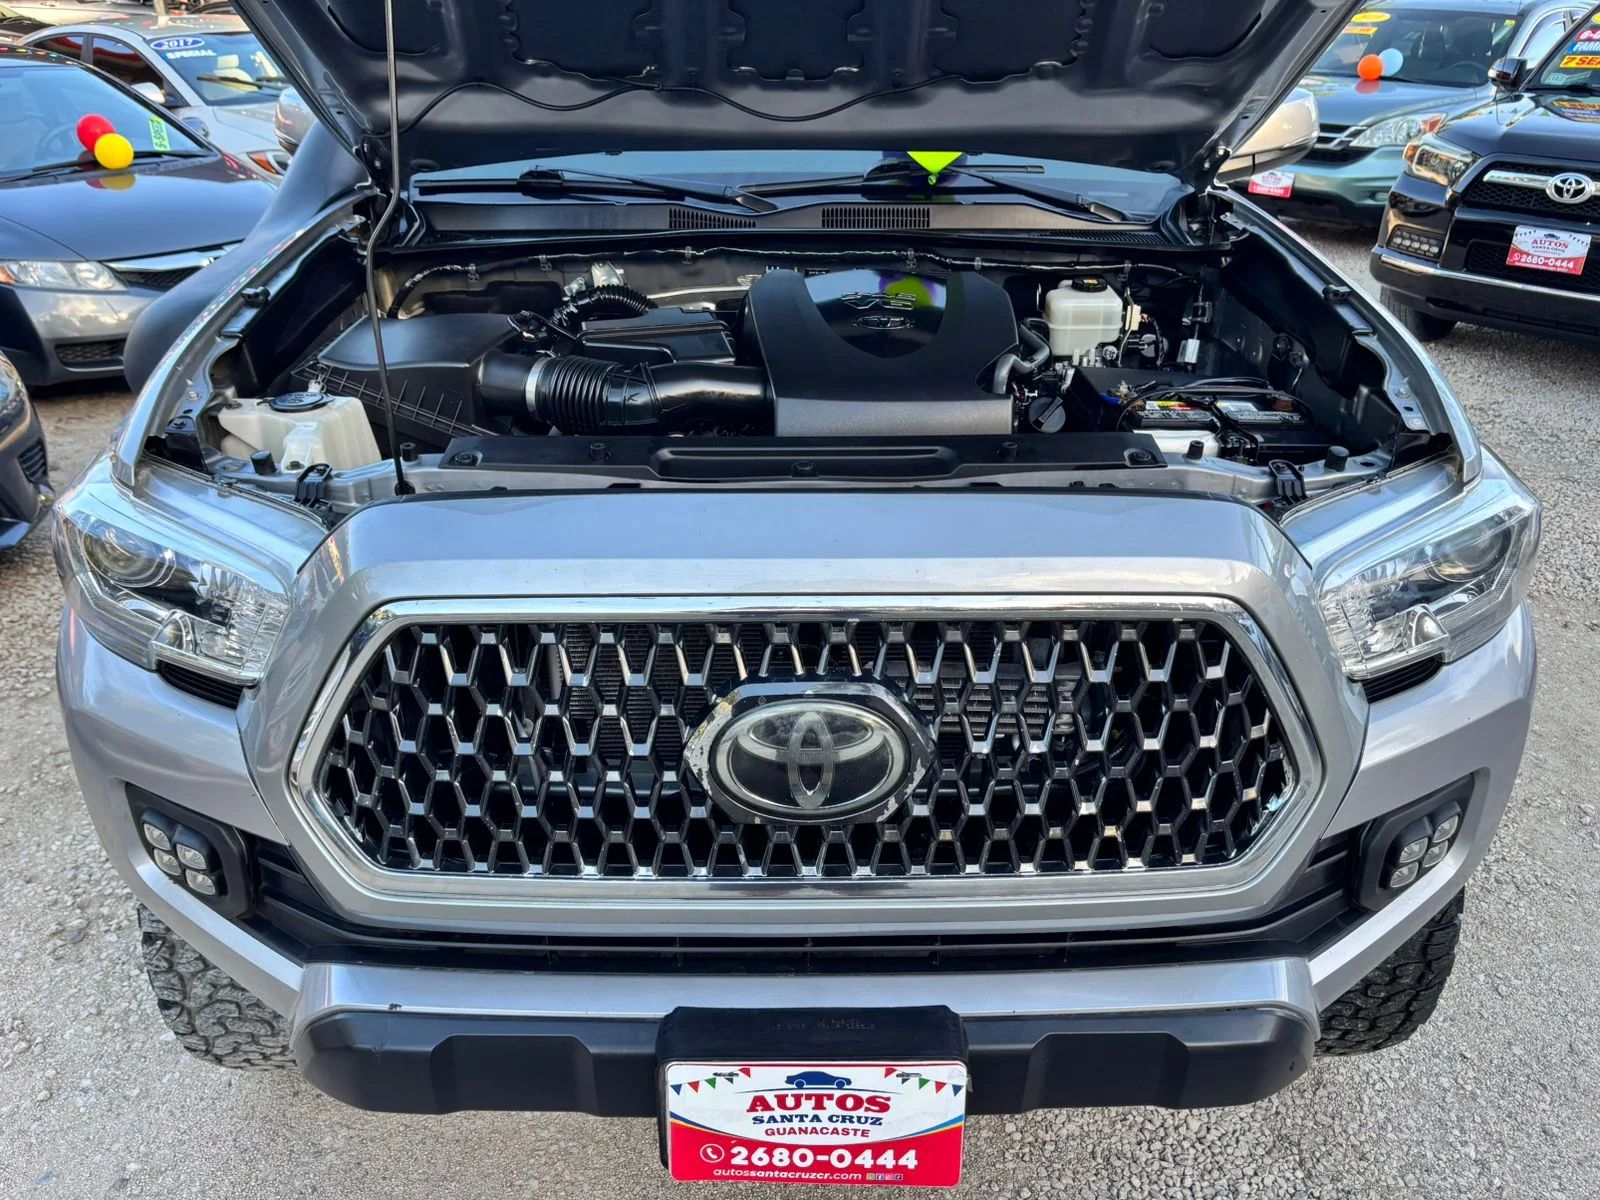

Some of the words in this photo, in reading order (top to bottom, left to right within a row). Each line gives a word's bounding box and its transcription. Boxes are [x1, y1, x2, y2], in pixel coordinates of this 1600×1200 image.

[162, 39, 194, 49] 2017
[1563, 57, 1577, 66] 7
[1532, 239, 1569, 249] AUTOS
[1520, 254, 1575, 269] 2680-0444
[746, 1093, 892, 1114] AUTOS
[752, 1114, 824, 1125] SANTA
[828, 1114, 884, 1126] CRUZ
[764, 1126, 871, 1138] GUANACASTE
[730, 1146, 919, 1170] 2680-0444
[713, 1168, 863, 1181] autossantacruzcr.com
